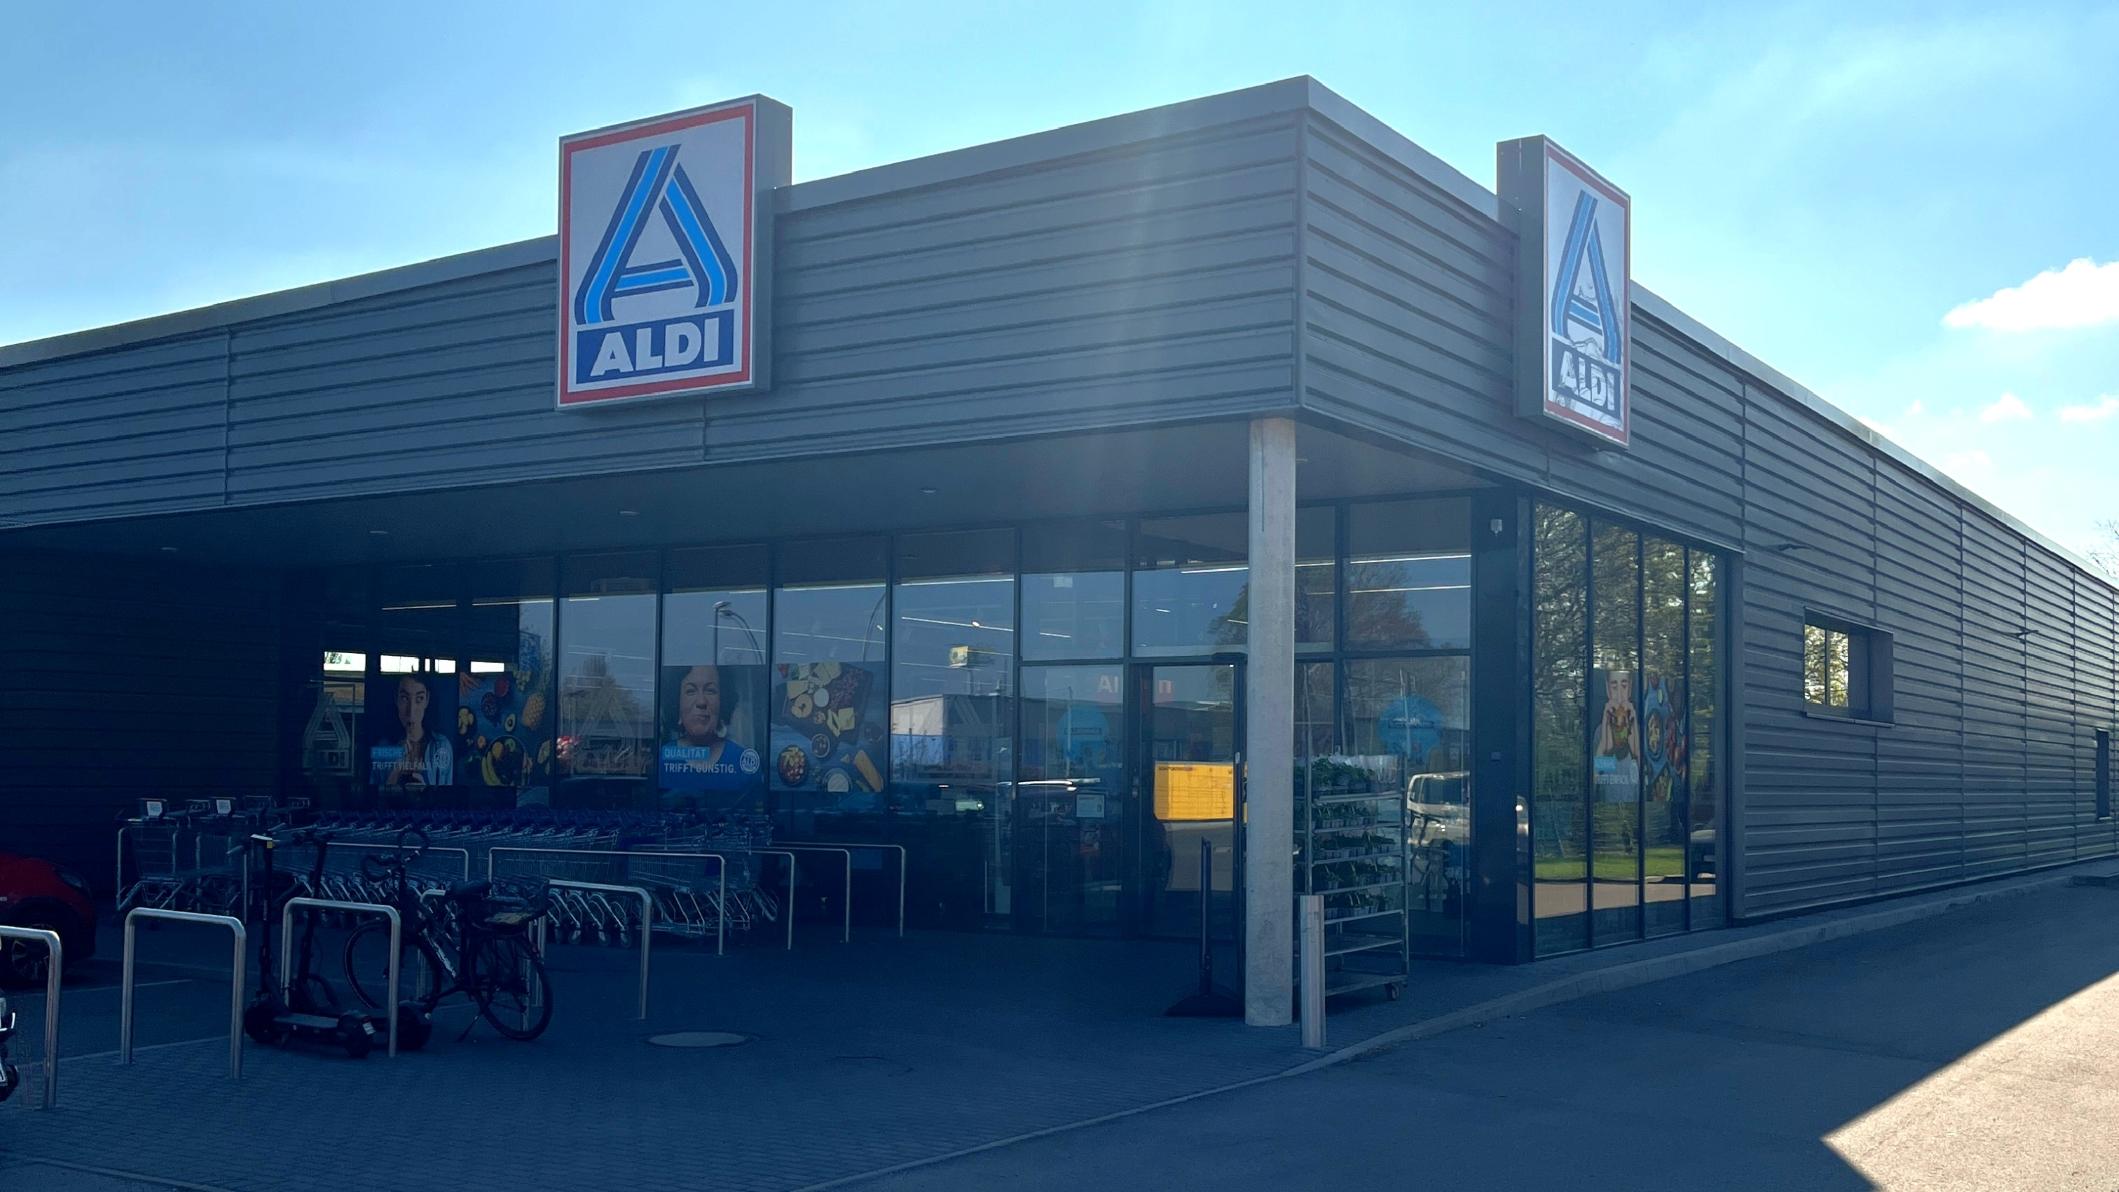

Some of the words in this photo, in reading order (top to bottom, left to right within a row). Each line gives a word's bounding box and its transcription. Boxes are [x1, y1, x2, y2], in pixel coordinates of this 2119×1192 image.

[590, 316, 720, 377] ALDI
[1558, 350, 1617, 412] ALDI
[664, 762, 694, 773] TRIFFT
